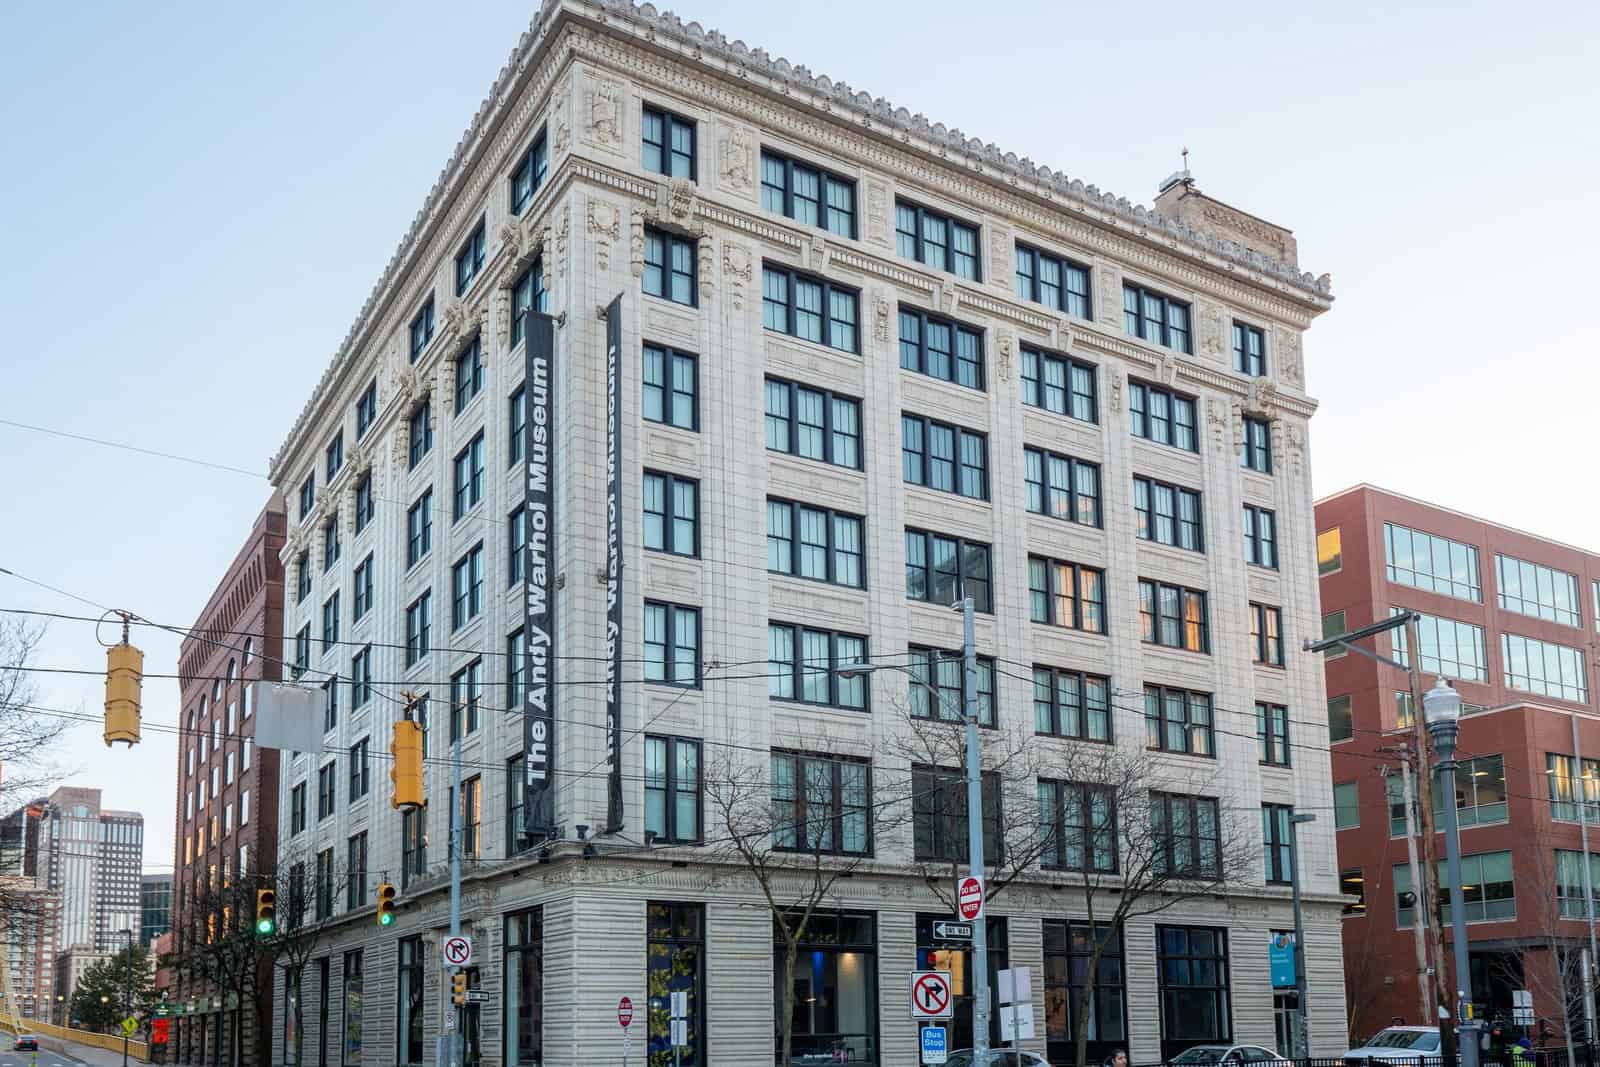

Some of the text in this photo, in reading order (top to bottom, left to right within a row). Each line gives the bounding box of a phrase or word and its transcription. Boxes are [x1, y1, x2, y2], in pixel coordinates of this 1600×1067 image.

[527, 356, 551, 786] The Andy Warhol Museum
[961, 884, 979, 895] DO NOT
[963, 903, 978, 913] ENTER
[926, 1030, 941, 1038] Bus
[924, 1038, 944, 1047] Stop
